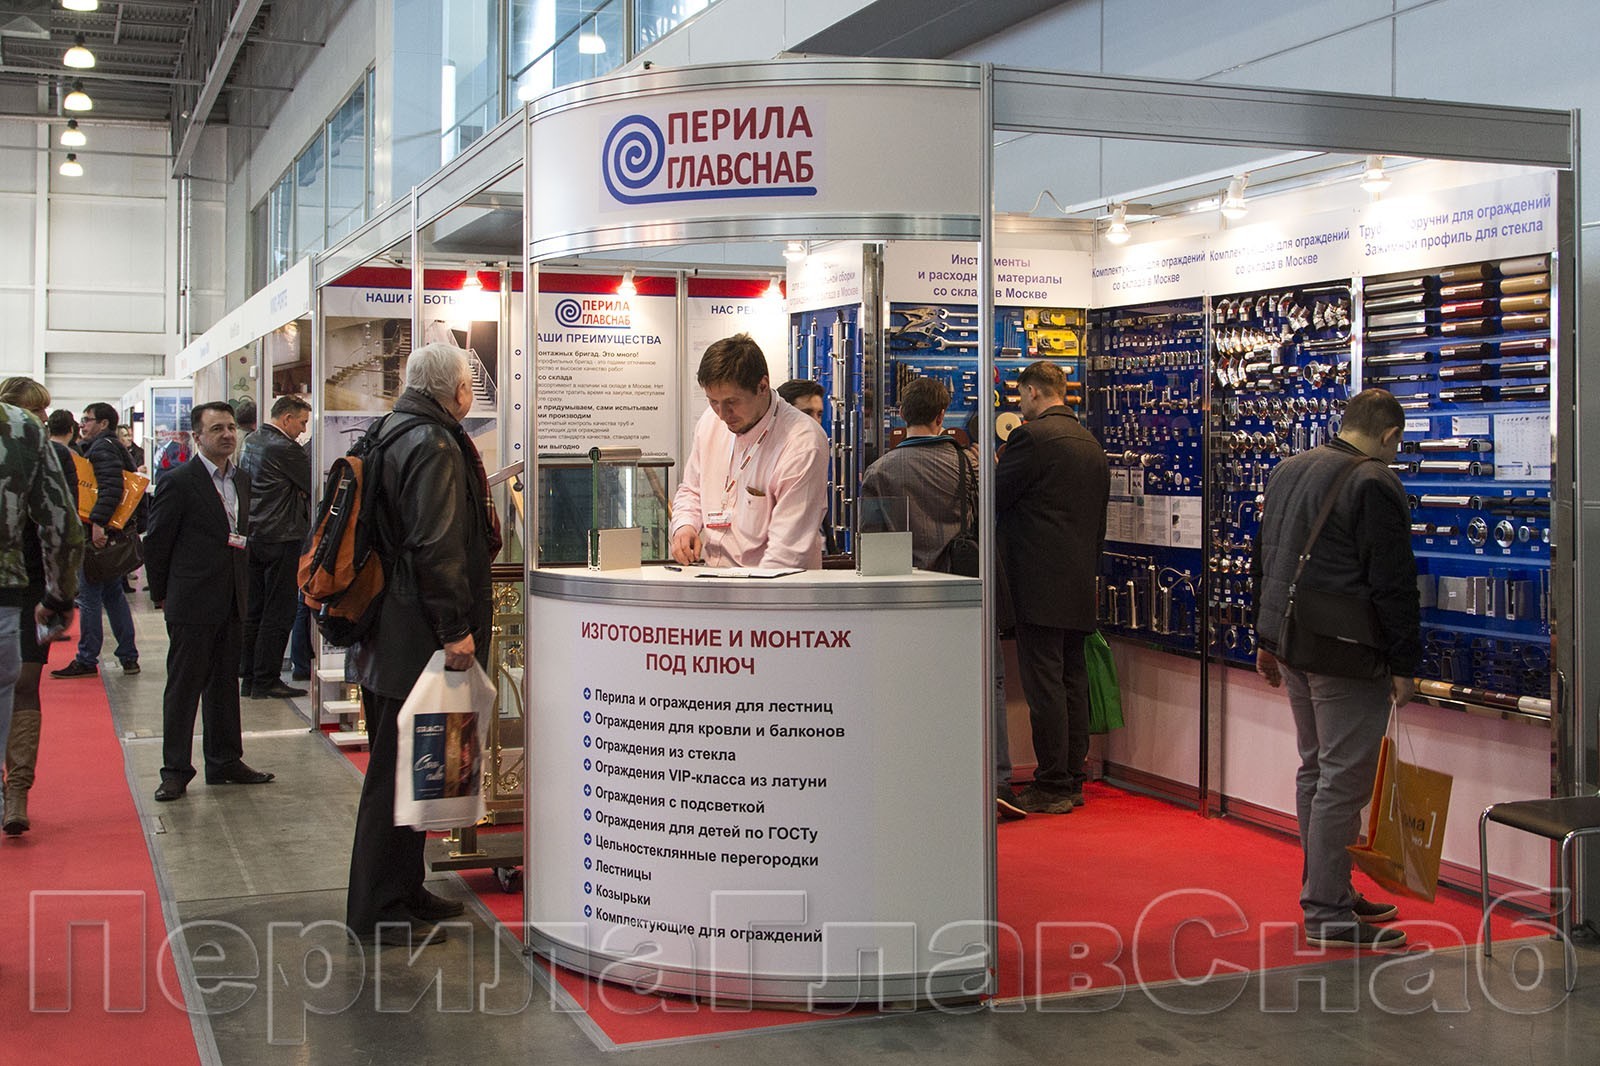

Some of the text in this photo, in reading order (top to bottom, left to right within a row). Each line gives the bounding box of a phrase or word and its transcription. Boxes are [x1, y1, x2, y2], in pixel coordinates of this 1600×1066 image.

[667, 105, 813, 145] ПЕРИЛА
[667, 150, 814, 189] ГЛАВСНАБ
[1405, 212, 1449, 231] оручни
[1451, 208, 1474, 224] для
[1476, 193, 1551, 220] ограждений
[1295, 227, 1350, 249] ограждений
[1420, 230, 1473, 250] профиль
[1475, 226, 1498, 242] для
[1501, 219, 1544, 236] стекла
[951, 254, 1031, 268] Инстменты
[1161, 250, 1206, 269] ограждений
[1285, 253, 1319, 268] Москве
[918, 271, 1063, 285] и расходн материалы
[1153, 272, 1180, 285] Москве
[366, 292, 404, 304] НАШИ
[933, 287, 1048, 299] со скла в Москве
[582, 300, 631, 311] ПЕРИЛА
[711, 305, 733, 315] НАС
[582, 314, 631, 325] ГЛАВСНАБ
[537, 333, 662, 345] АШИ ПРЕИМУЩЕСТВА
[602, 350, 615, 358] Это
[616, 351, 639, 359] много!
[581, 621, 852, 649] ИЗГОТОВЛЕНИЕ И МОНТАЖ
[646, 653, 755, 676] ПОД КЛЮЧ
[595, 688, 834, 715] Перила и ограждения для лестниц
[595, 712, 845, 738] Ограждения для кровли и балконов
[595, 736, 736, 761] Ограждения из стекла
[595, 760, 827, 791] Ограждения VIP-класса из латуни
[595, 785, 765, 813] Ограждения с подсветкой
[595, 810, 819, 844] Ограждения для детей по ГОСТу
[595, 834, 819, 869] Цельностеклянные перегородки
[595, 859, 653, 882] Лестницы
[595, 884, 652, 906] Козырьки
[595, 907, 824, 944] Комплектующие для ограждений
